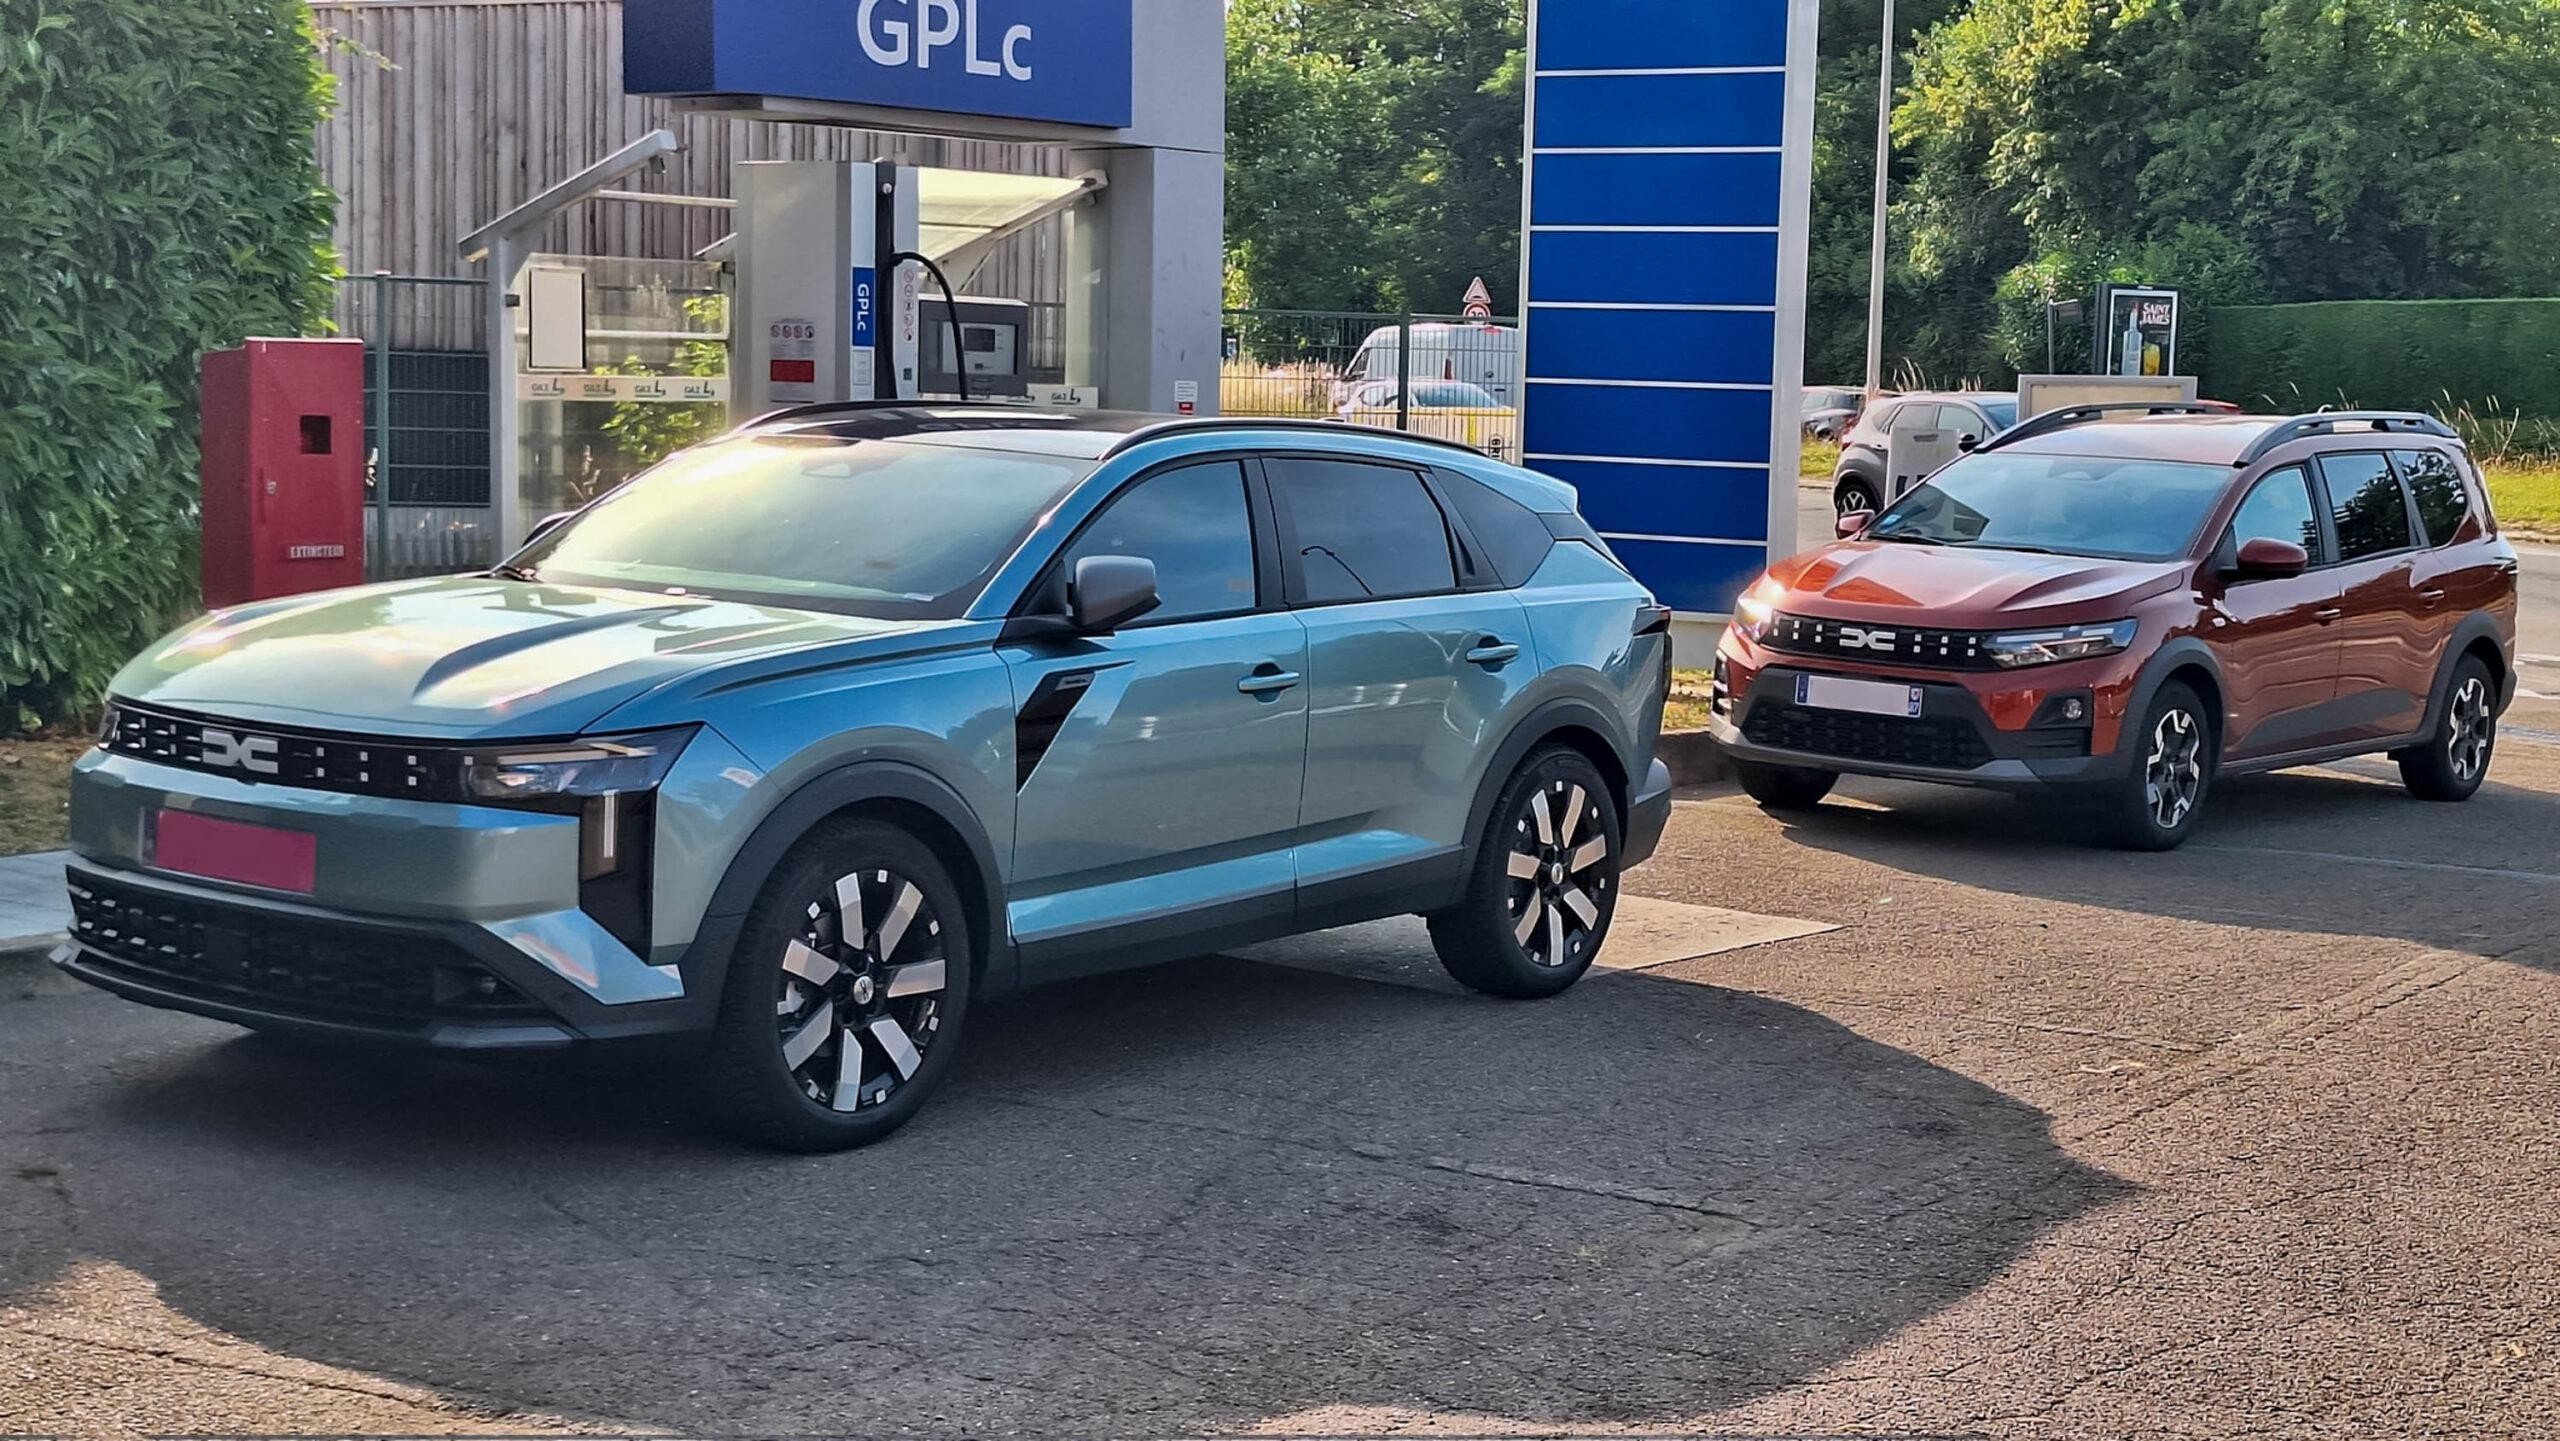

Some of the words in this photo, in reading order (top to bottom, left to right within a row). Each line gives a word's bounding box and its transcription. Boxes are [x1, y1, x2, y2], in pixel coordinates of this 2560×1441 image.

[856, 0, 1032, 81] GPLc
[857, 283, 870, 332] GPLc
[2139, 312, 2171, 326] JAMES
[2143, 302, 2171, 316] SAINT
